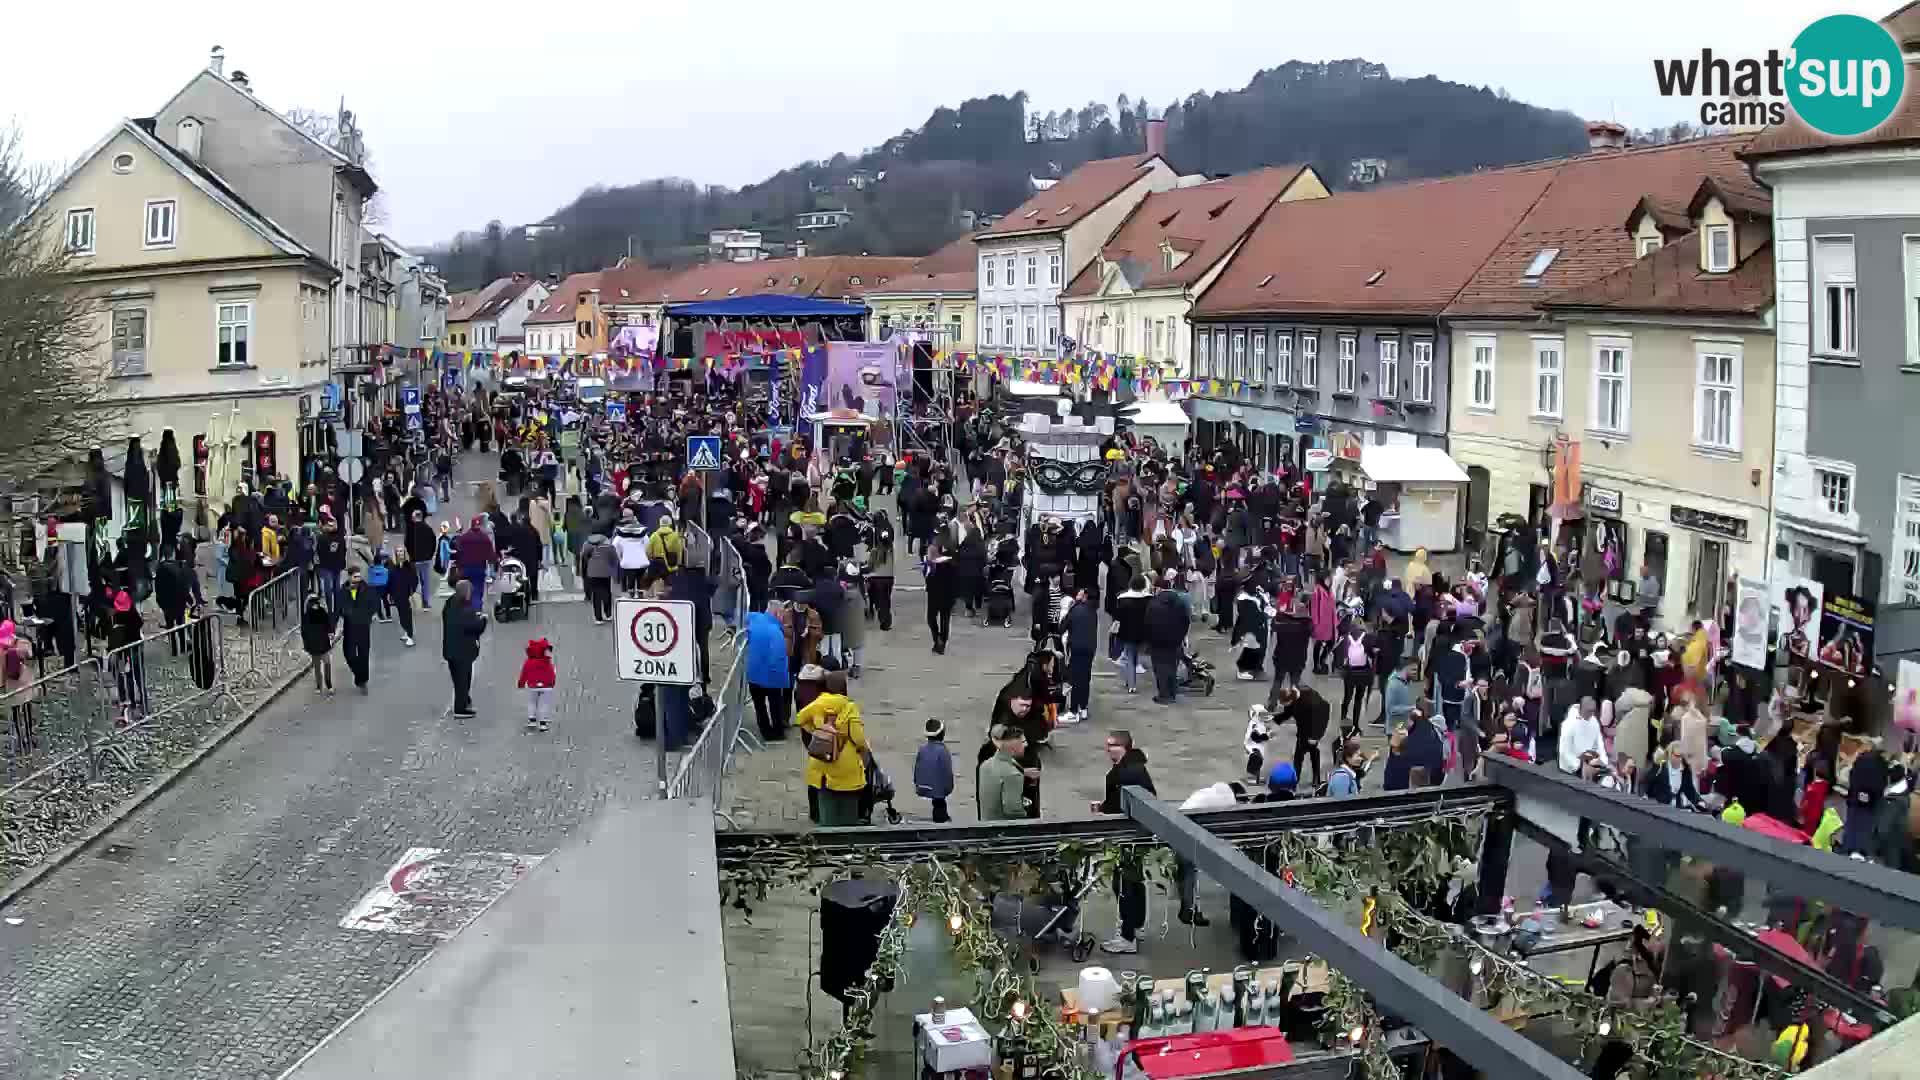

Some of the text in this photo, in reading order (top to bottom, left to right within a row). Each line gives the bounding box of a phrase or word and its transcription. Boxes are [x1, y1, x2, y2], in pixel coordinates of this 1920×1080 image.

[408, 391, 416, 402] P
[643, 622, 667, 643] 30
[633, 659, 678, 677] ZONA
